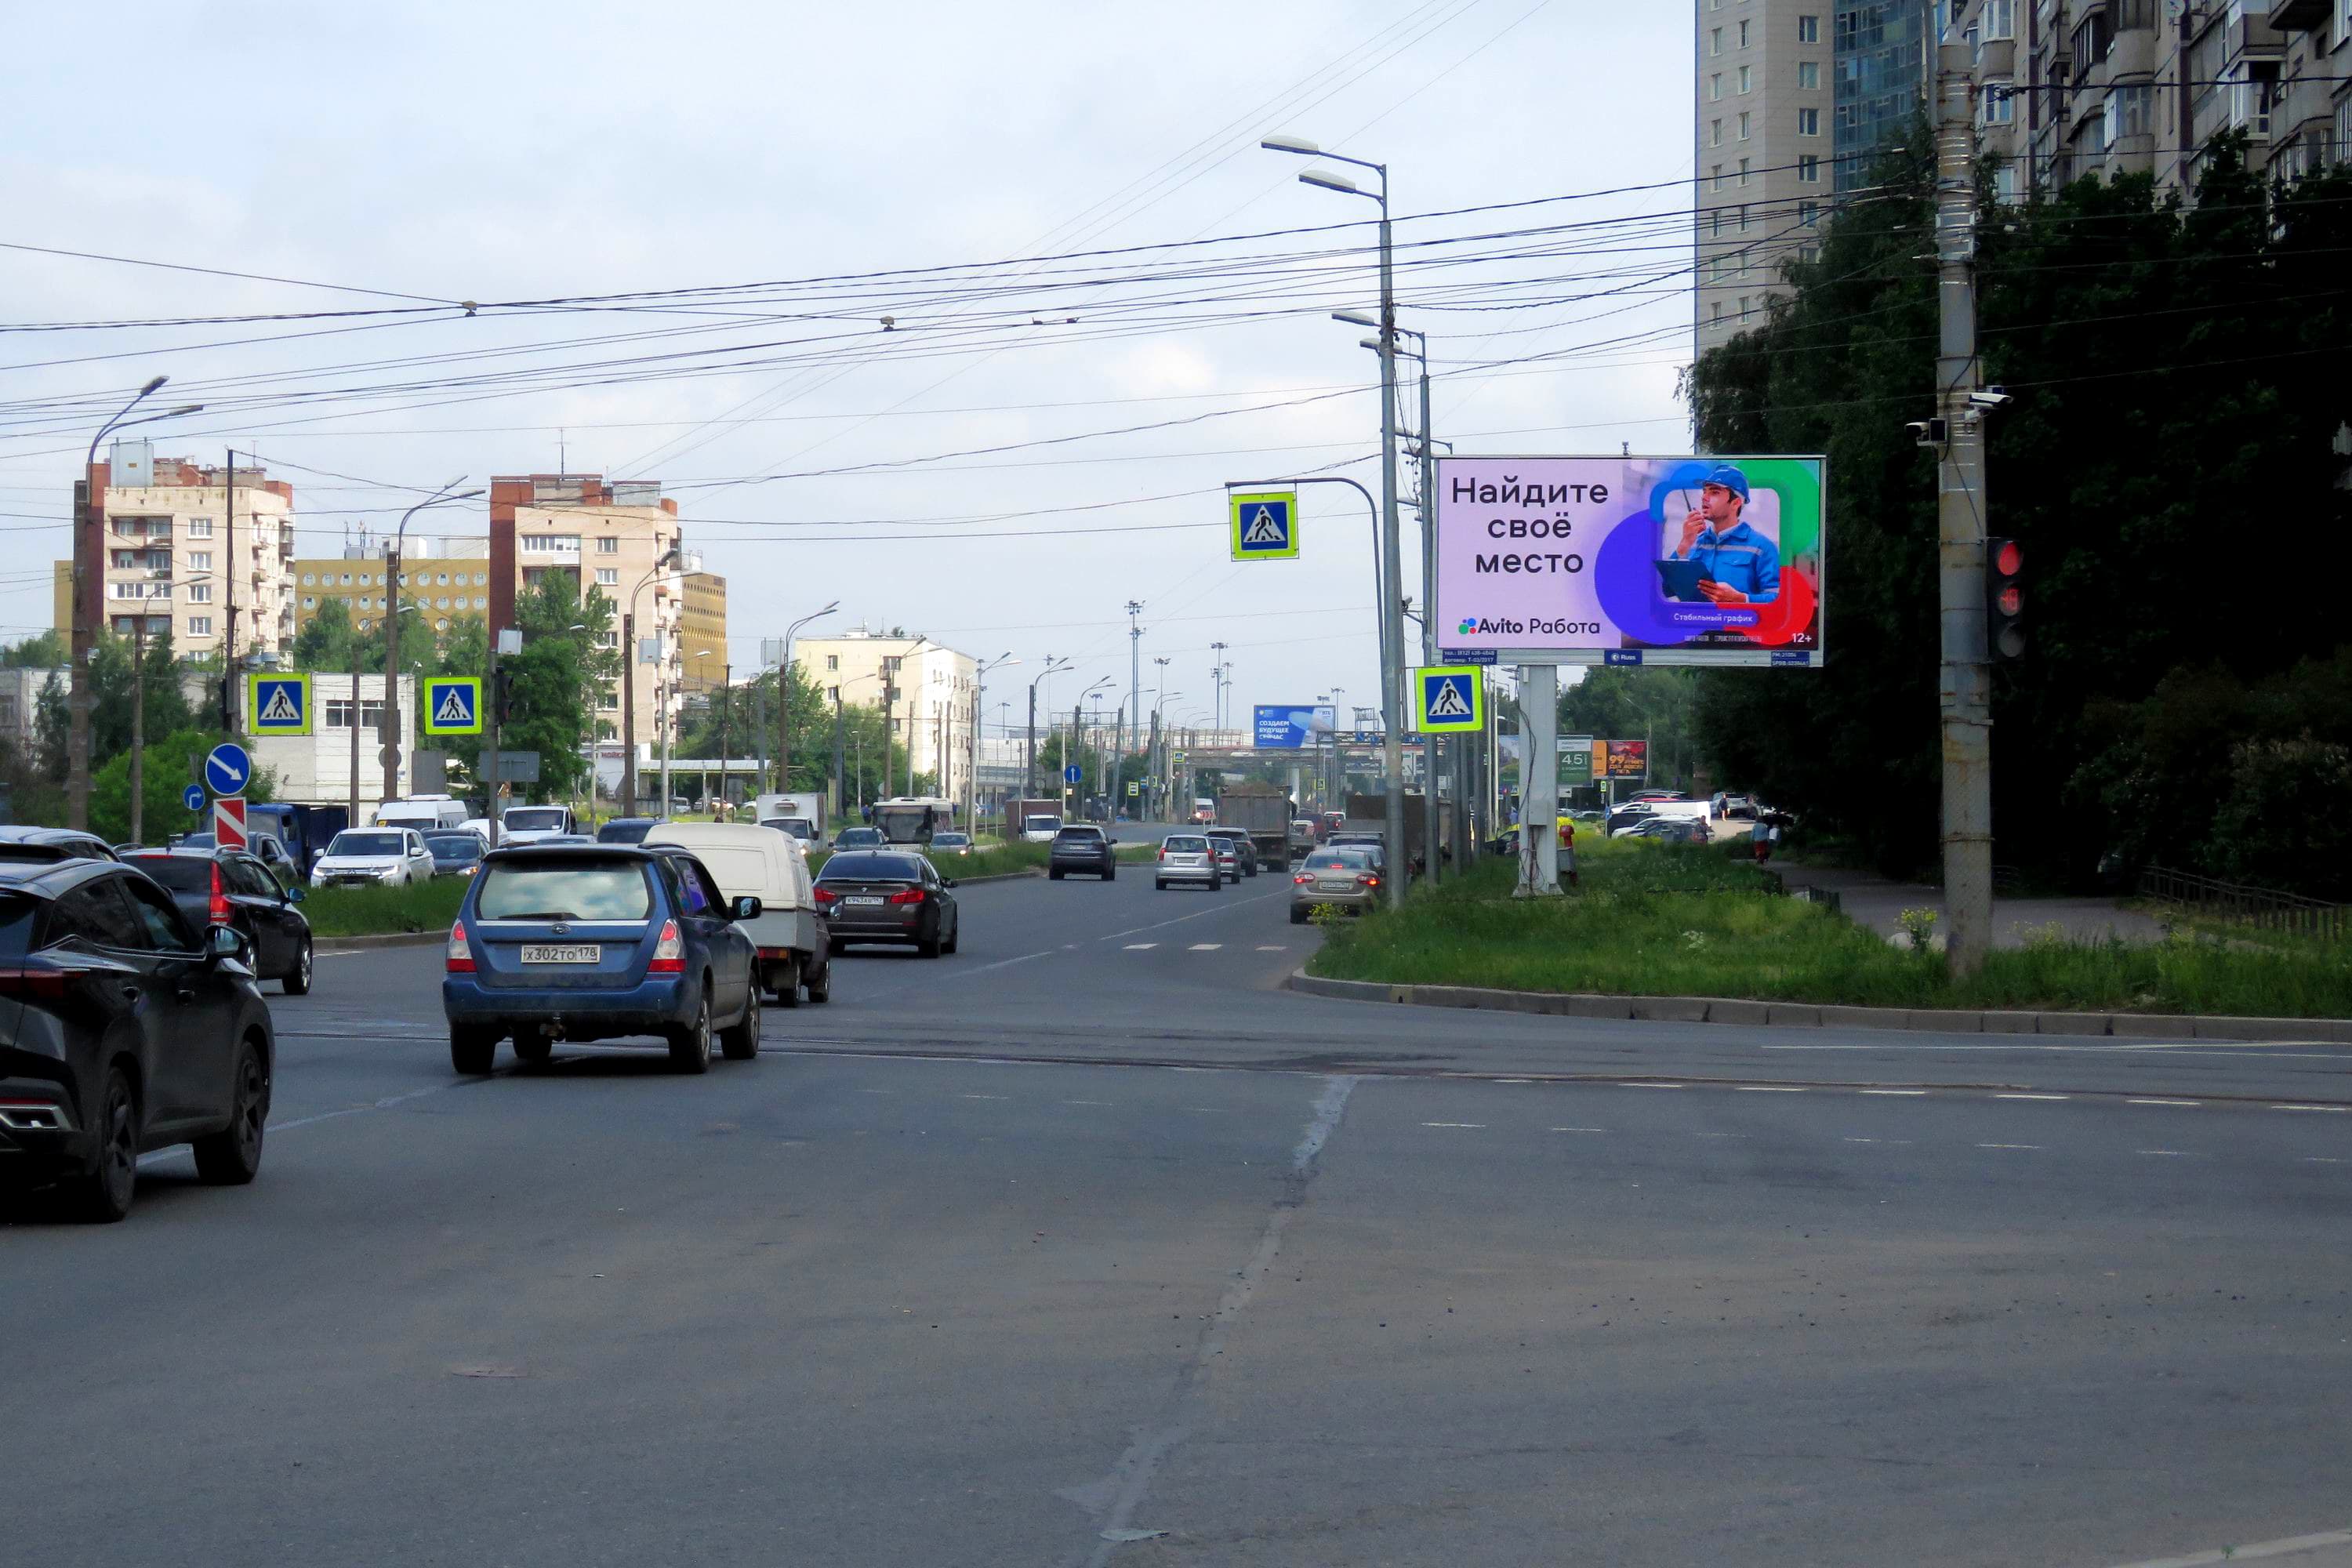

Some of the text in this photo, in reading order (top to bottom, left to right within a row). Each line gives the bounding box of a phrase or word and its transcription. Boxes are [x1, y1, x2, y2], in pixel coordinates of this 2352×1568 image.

[1453, 475, 1608, 507] Найдите
[1487, 511, 1571, 538] своё
[1475, 554, 1584, 573] место
[1477, 618, 1600, 634] Avito Работа
[1673, 612, 1753, 623] Стабильный график
[1791, 633, 1813, 643] 12+
